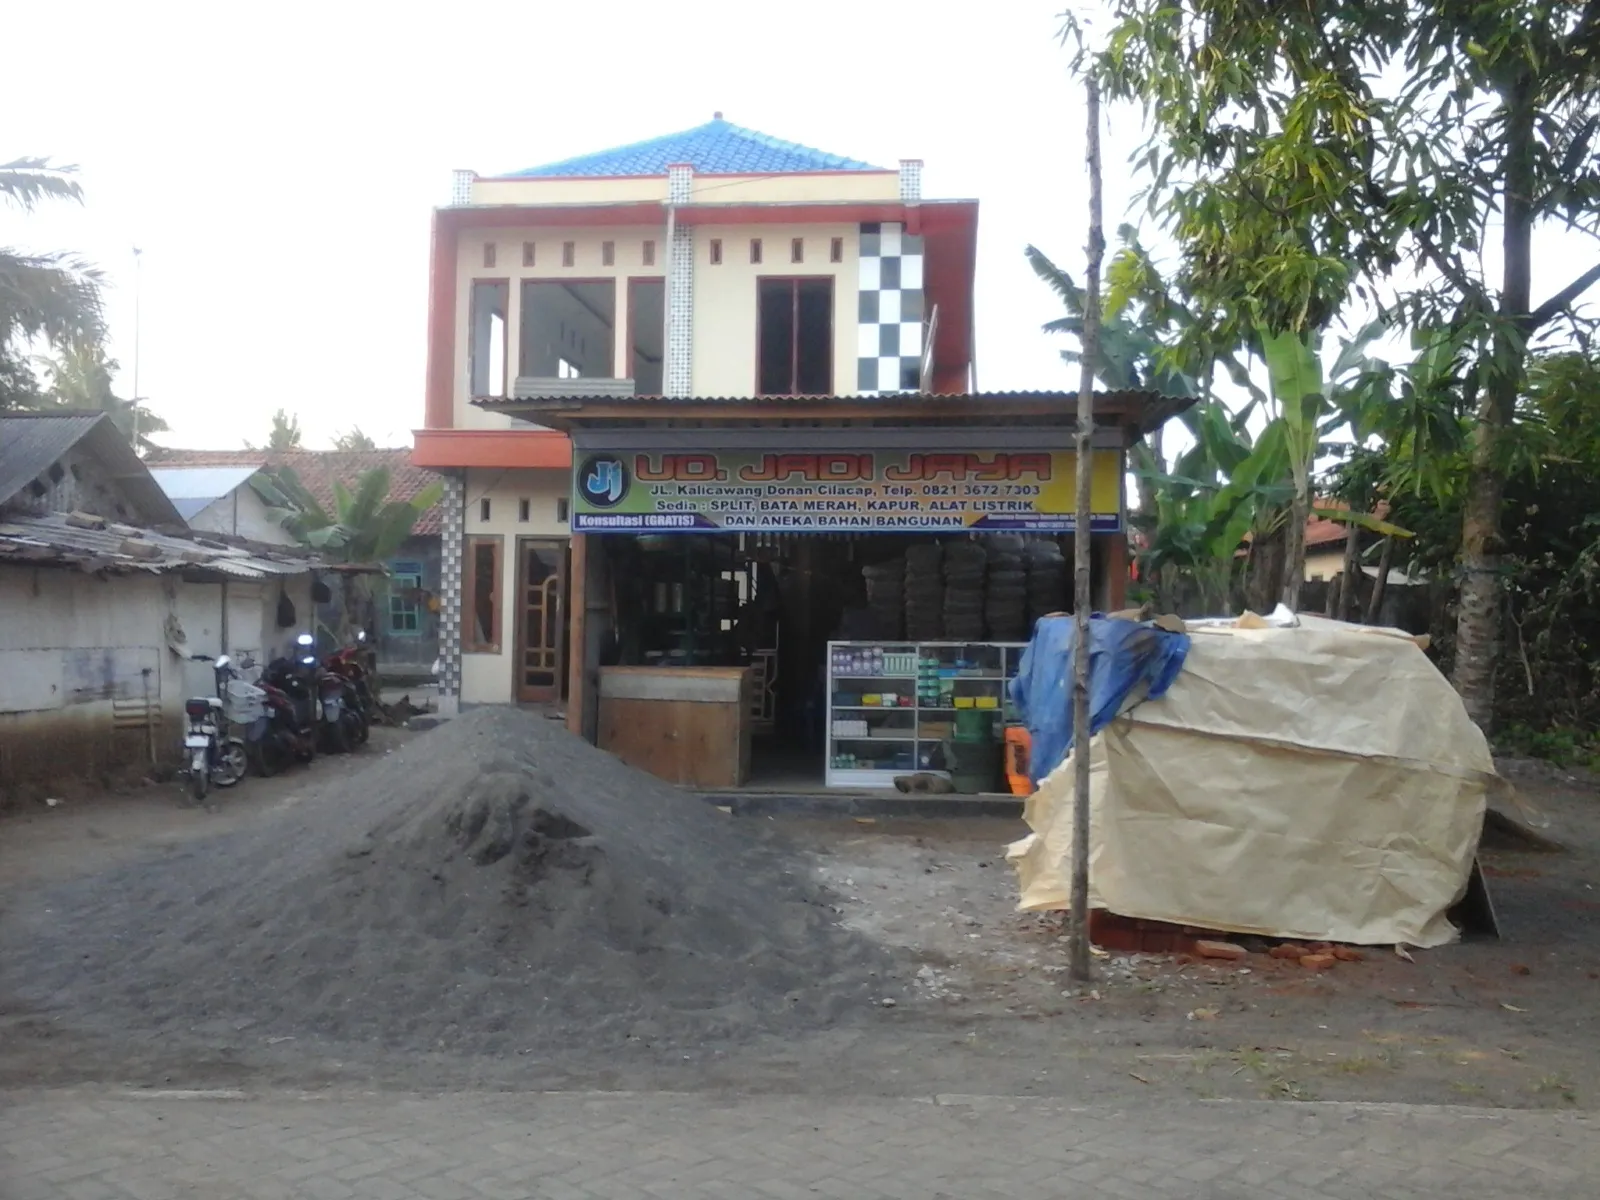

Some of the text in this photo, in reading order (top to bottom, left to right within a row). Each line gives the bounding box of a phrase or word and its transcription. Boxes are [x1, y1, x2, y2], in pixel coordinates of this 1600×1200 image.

[635, 453, 1051, 481] UD. JADI JAYA
[651, 485, 1041, 497] JL. Kalicawang Donan Cilacap, Telp. 0821 3672 7303
[657, 500, 696, 510] Sedia
[711, 500, 755, 512] SPLIT,
[761, 500, 798, 510] BATA
[803, 500, 862, 512] MERAH,
[868, 500, 925, 511] KAPUR,
[929, 500, 968, 510] ALAT
[973, 500, 1033, 510] LISTRIK
[579, 514, 694, 527] Konsultasi (GRATIS)
[725, 516, 963, 526] DAN ANEKA BAHAN BANGUNAN
